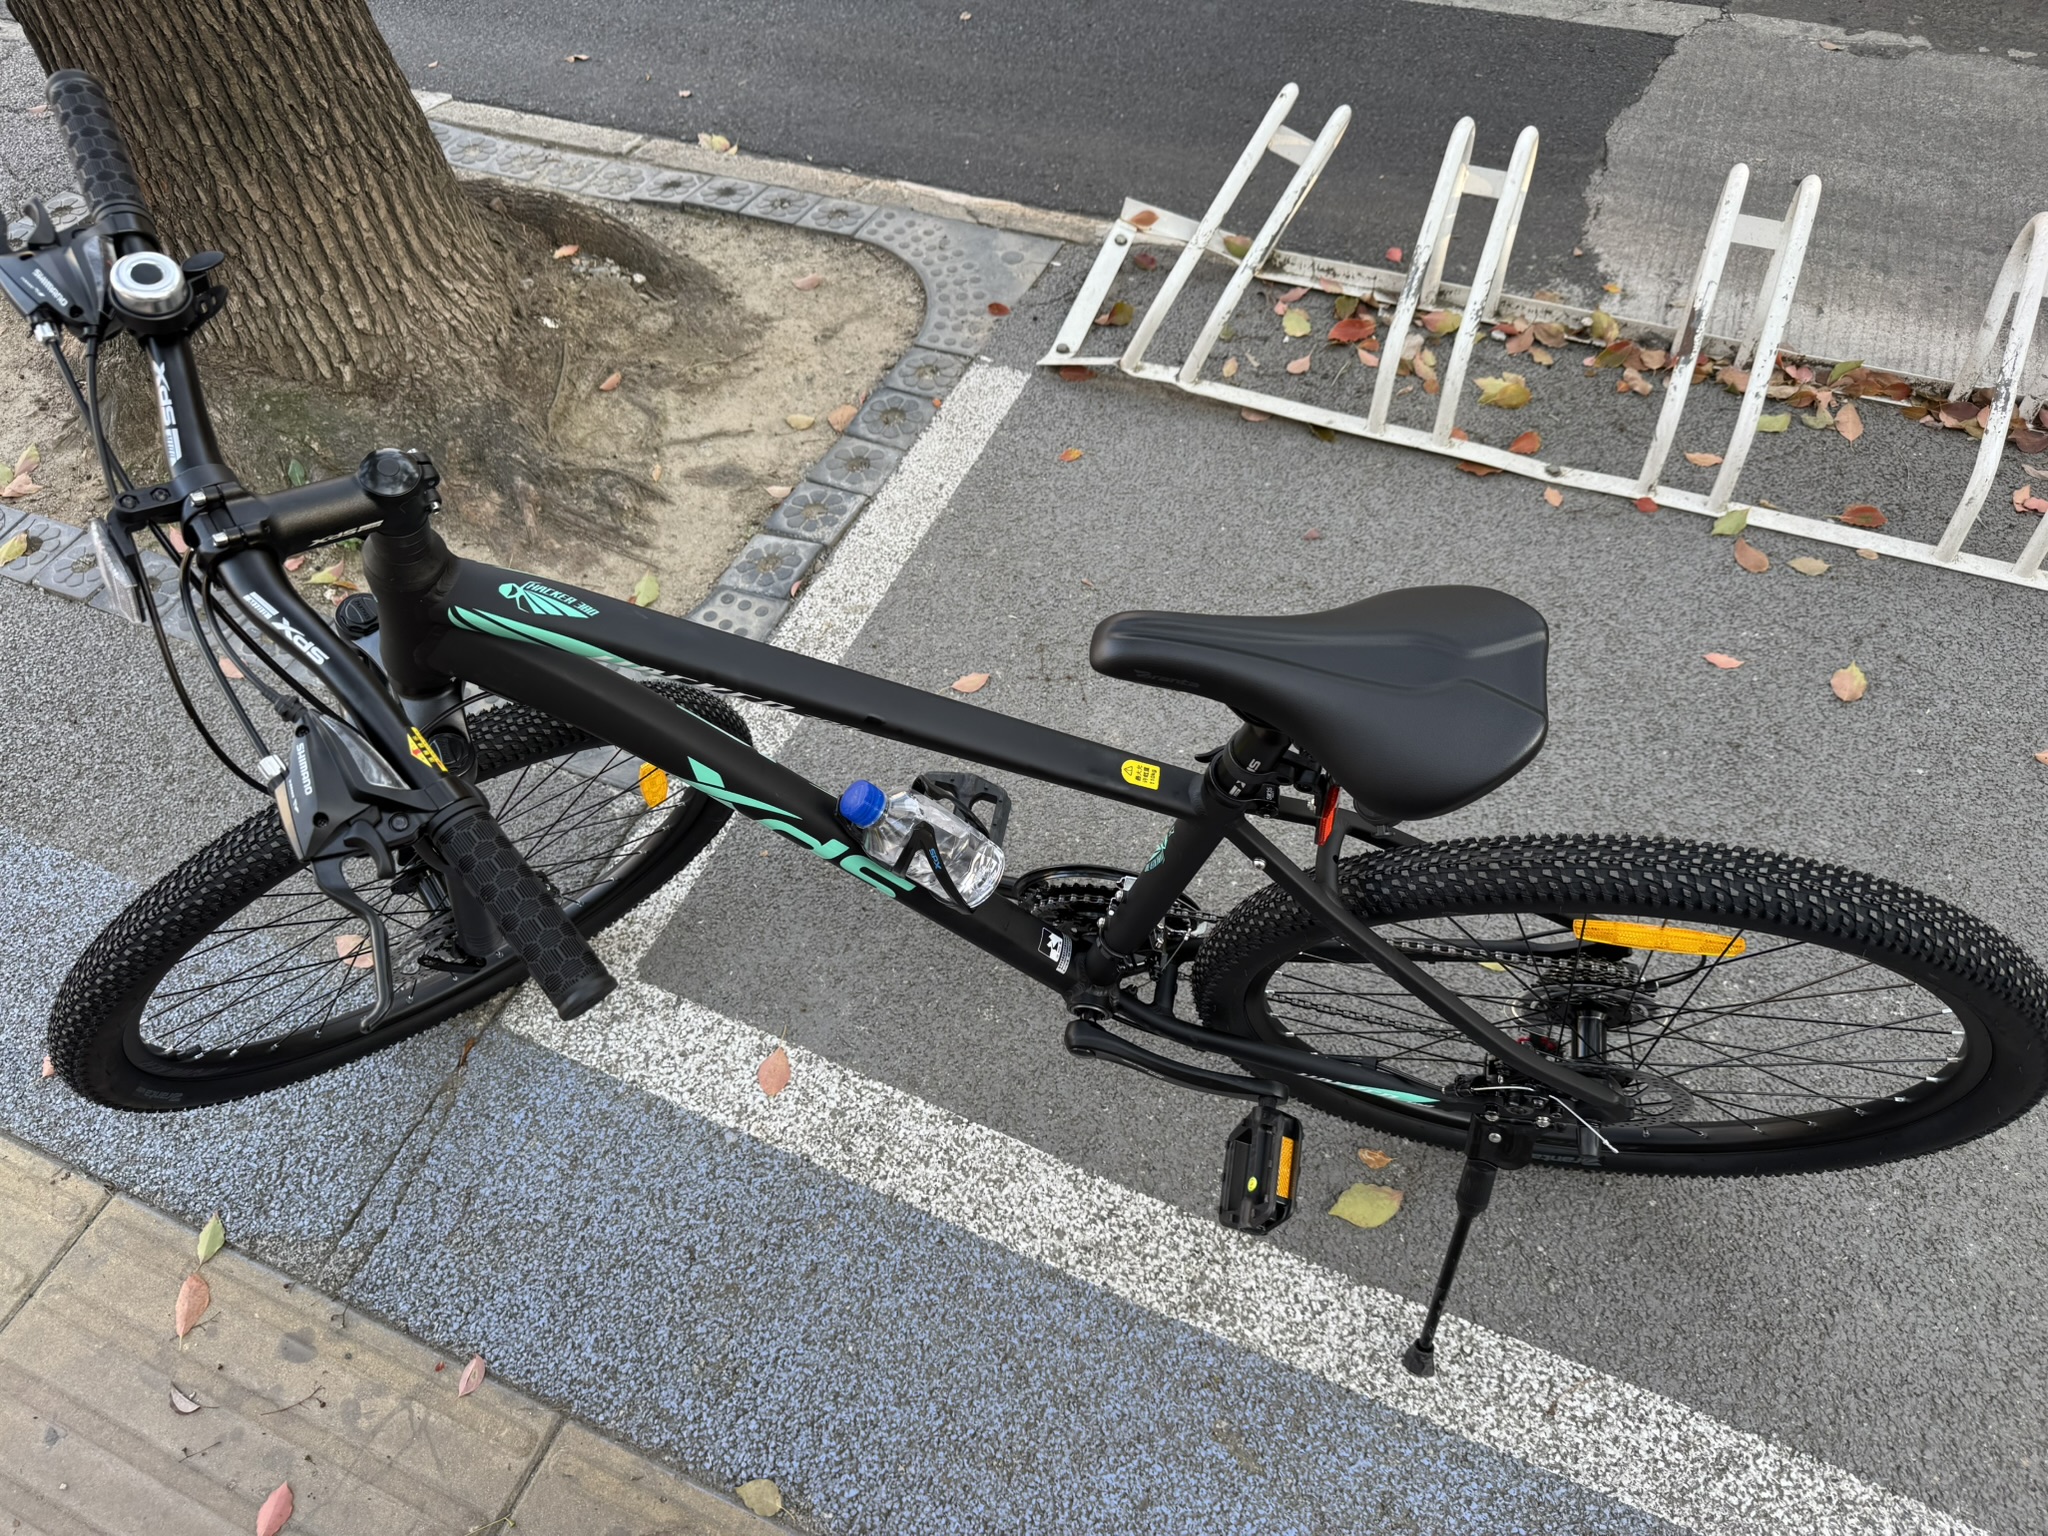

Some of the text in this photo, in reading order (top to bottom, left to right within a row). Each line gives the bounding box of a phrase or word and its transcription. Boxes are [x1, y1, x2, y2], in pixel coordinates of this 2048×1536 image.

[31, 268, 68, 307] SHIMANO
[525, 582, 600, 616] HACKER 380
[296, 742, 313, 796] SHIMANO
